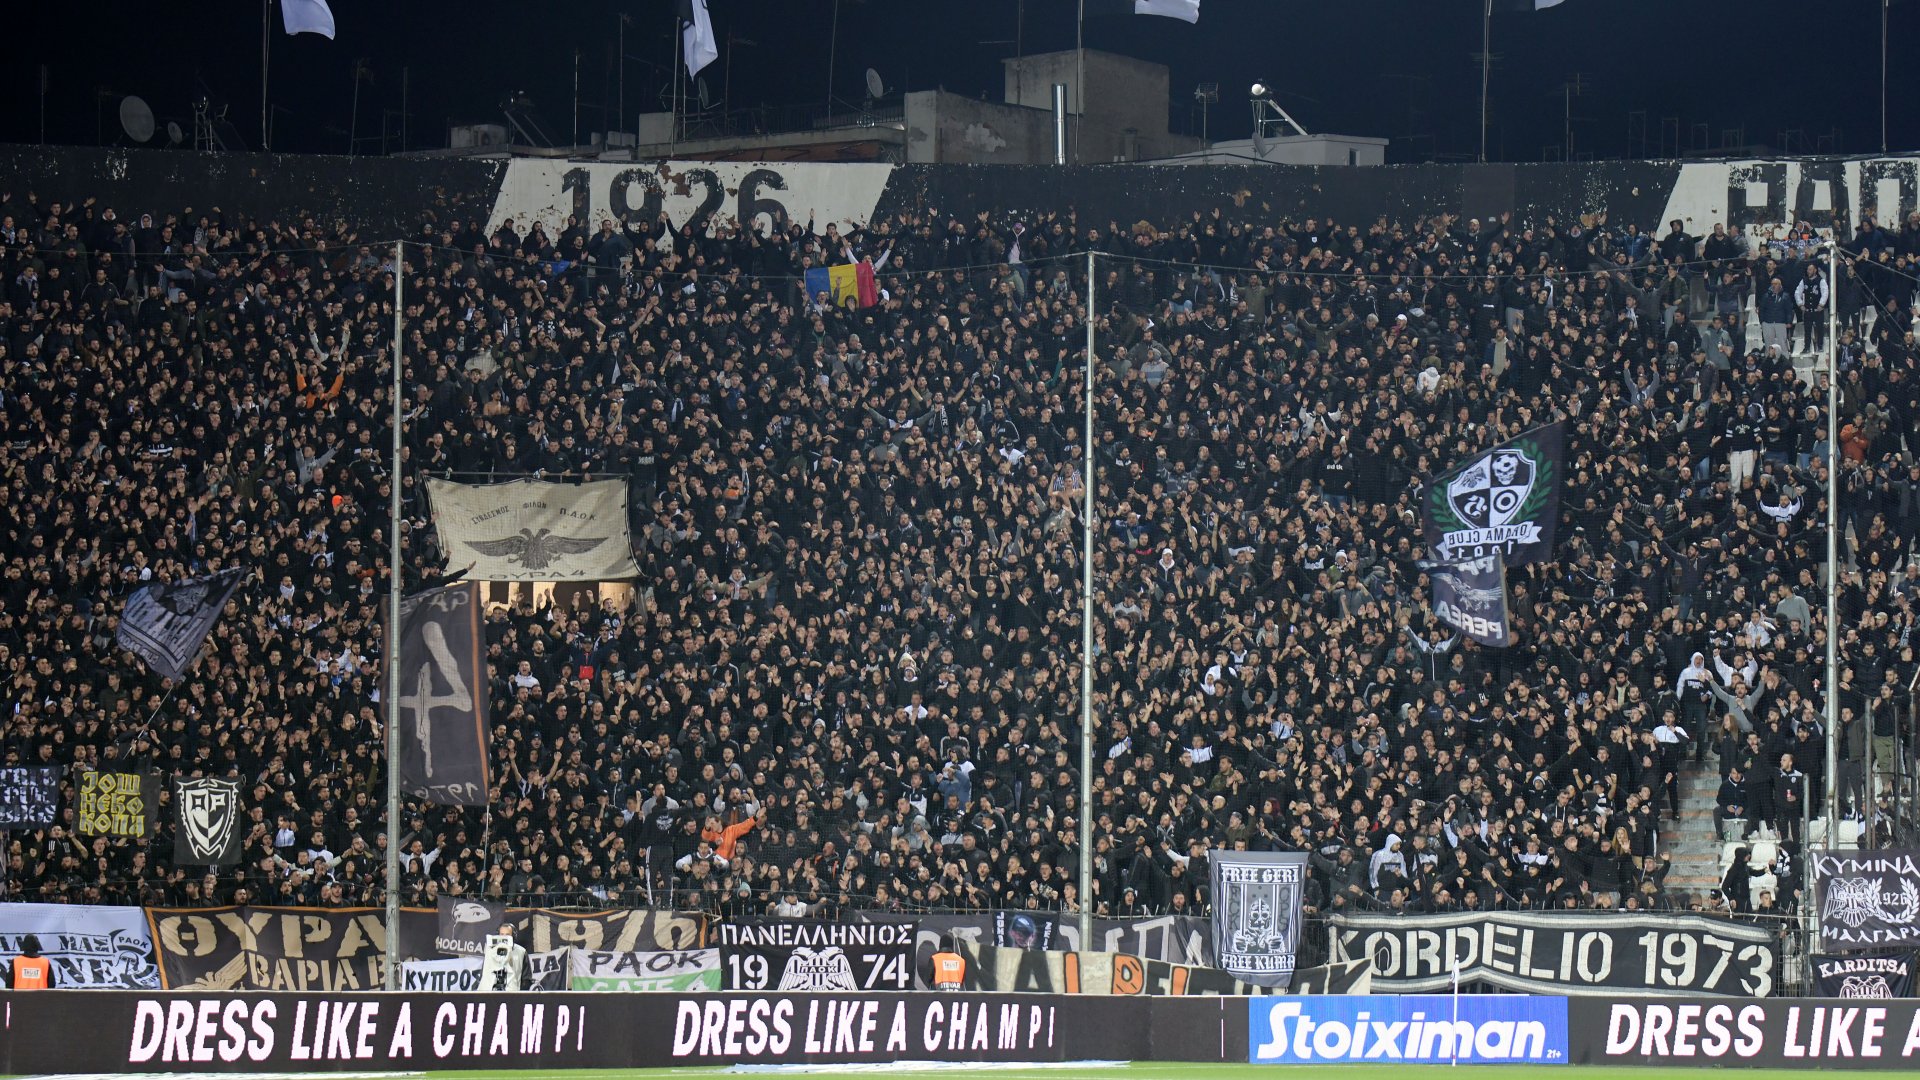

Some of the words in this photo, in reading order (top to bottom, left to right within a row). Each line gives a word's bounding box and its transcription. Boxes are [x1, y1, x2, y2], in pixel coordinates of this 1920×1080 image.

[562, 167, 788, 240] 1926
[489, 571, 566, 580] ΘΥΡΑ
[1221, 867, 1258, 882] FREE
[1262, 868, 1299, 883] GERI
[159, 913, 386, 957] ΘΥΡΑ
[435, 936, 487, 954] HOOLIGA
[519, 910, 698, 951] 1976
[722, 923, 912, 945] ΠΑΝΕΛΛΗΝΙΟΣ
[588, 951, 706, 976] PAOK
[728, 953, 768, 990] 19
[863, 953, 909, 990] 74
[1222, 953, 1253, 969] FREE
[1255, 955, 1296, 970] KUMA
[1329, 922, 1613, 982] KORDELIO
[1638, 931, 1773, 997] 1973
[1818, 958, 1908, 978] KARDITSA
[405, 969, 482, 991] ΚΥΠΡΟΣ
[129, 999, 277, 1062] DRESS
[290, 1000, 380, 1060] LIKE
[388, 1002, 412, 1058] A
[672, 999, 794, 1057] DRESS
[804, 1000, 879, 1054] LIKE
[886, 1001, 906, 1051] A
[1257, 1002, 1546, 1059] Stoiximan
[1604, 1004, 1765, 1057] DRESS
[1783, 1006, 1887, 1057] LIKE
